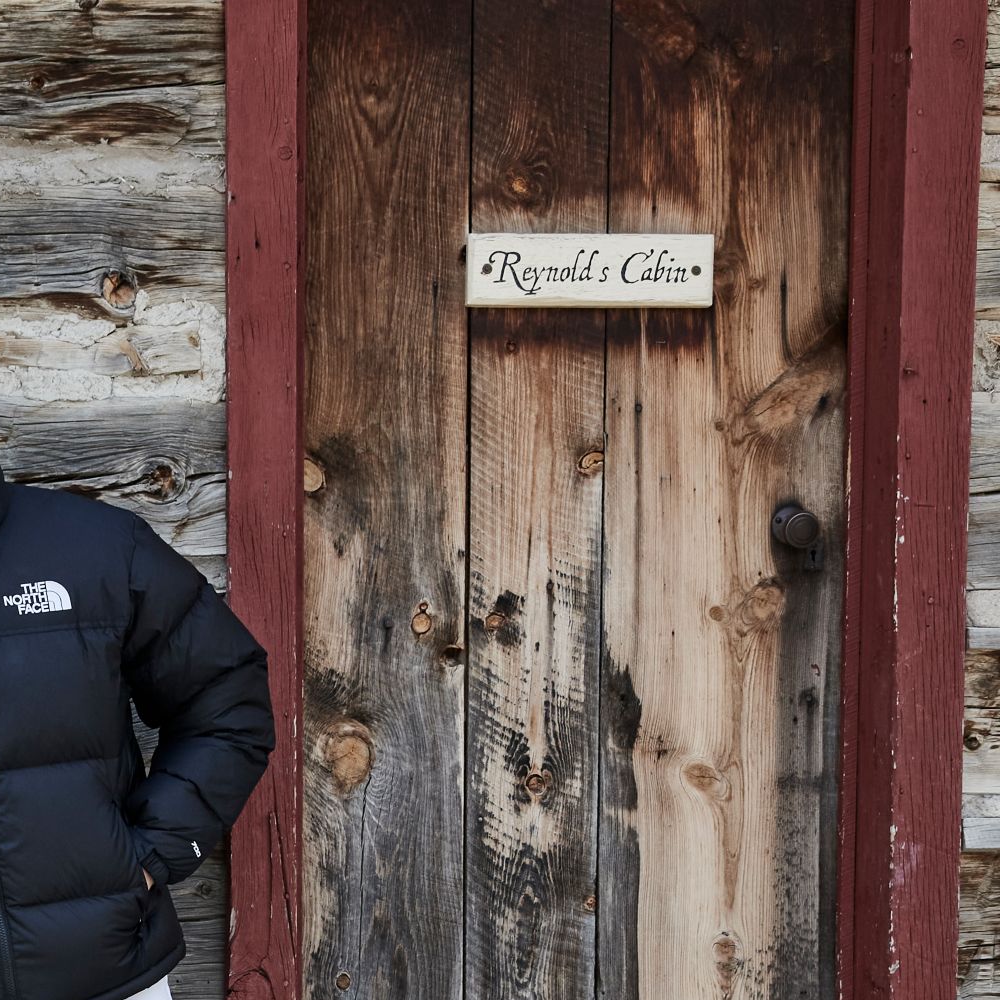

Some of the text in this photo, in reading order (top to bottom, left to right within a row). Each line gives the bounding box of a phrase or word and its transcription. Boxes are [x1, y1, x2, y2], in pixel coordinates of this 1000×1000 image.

[620, 248, 689, 284] Cabin
[20, 581, 47, 594] THE
[3, 591, 48, 607] NORTH
[17, 601, 50, 615] FACE
